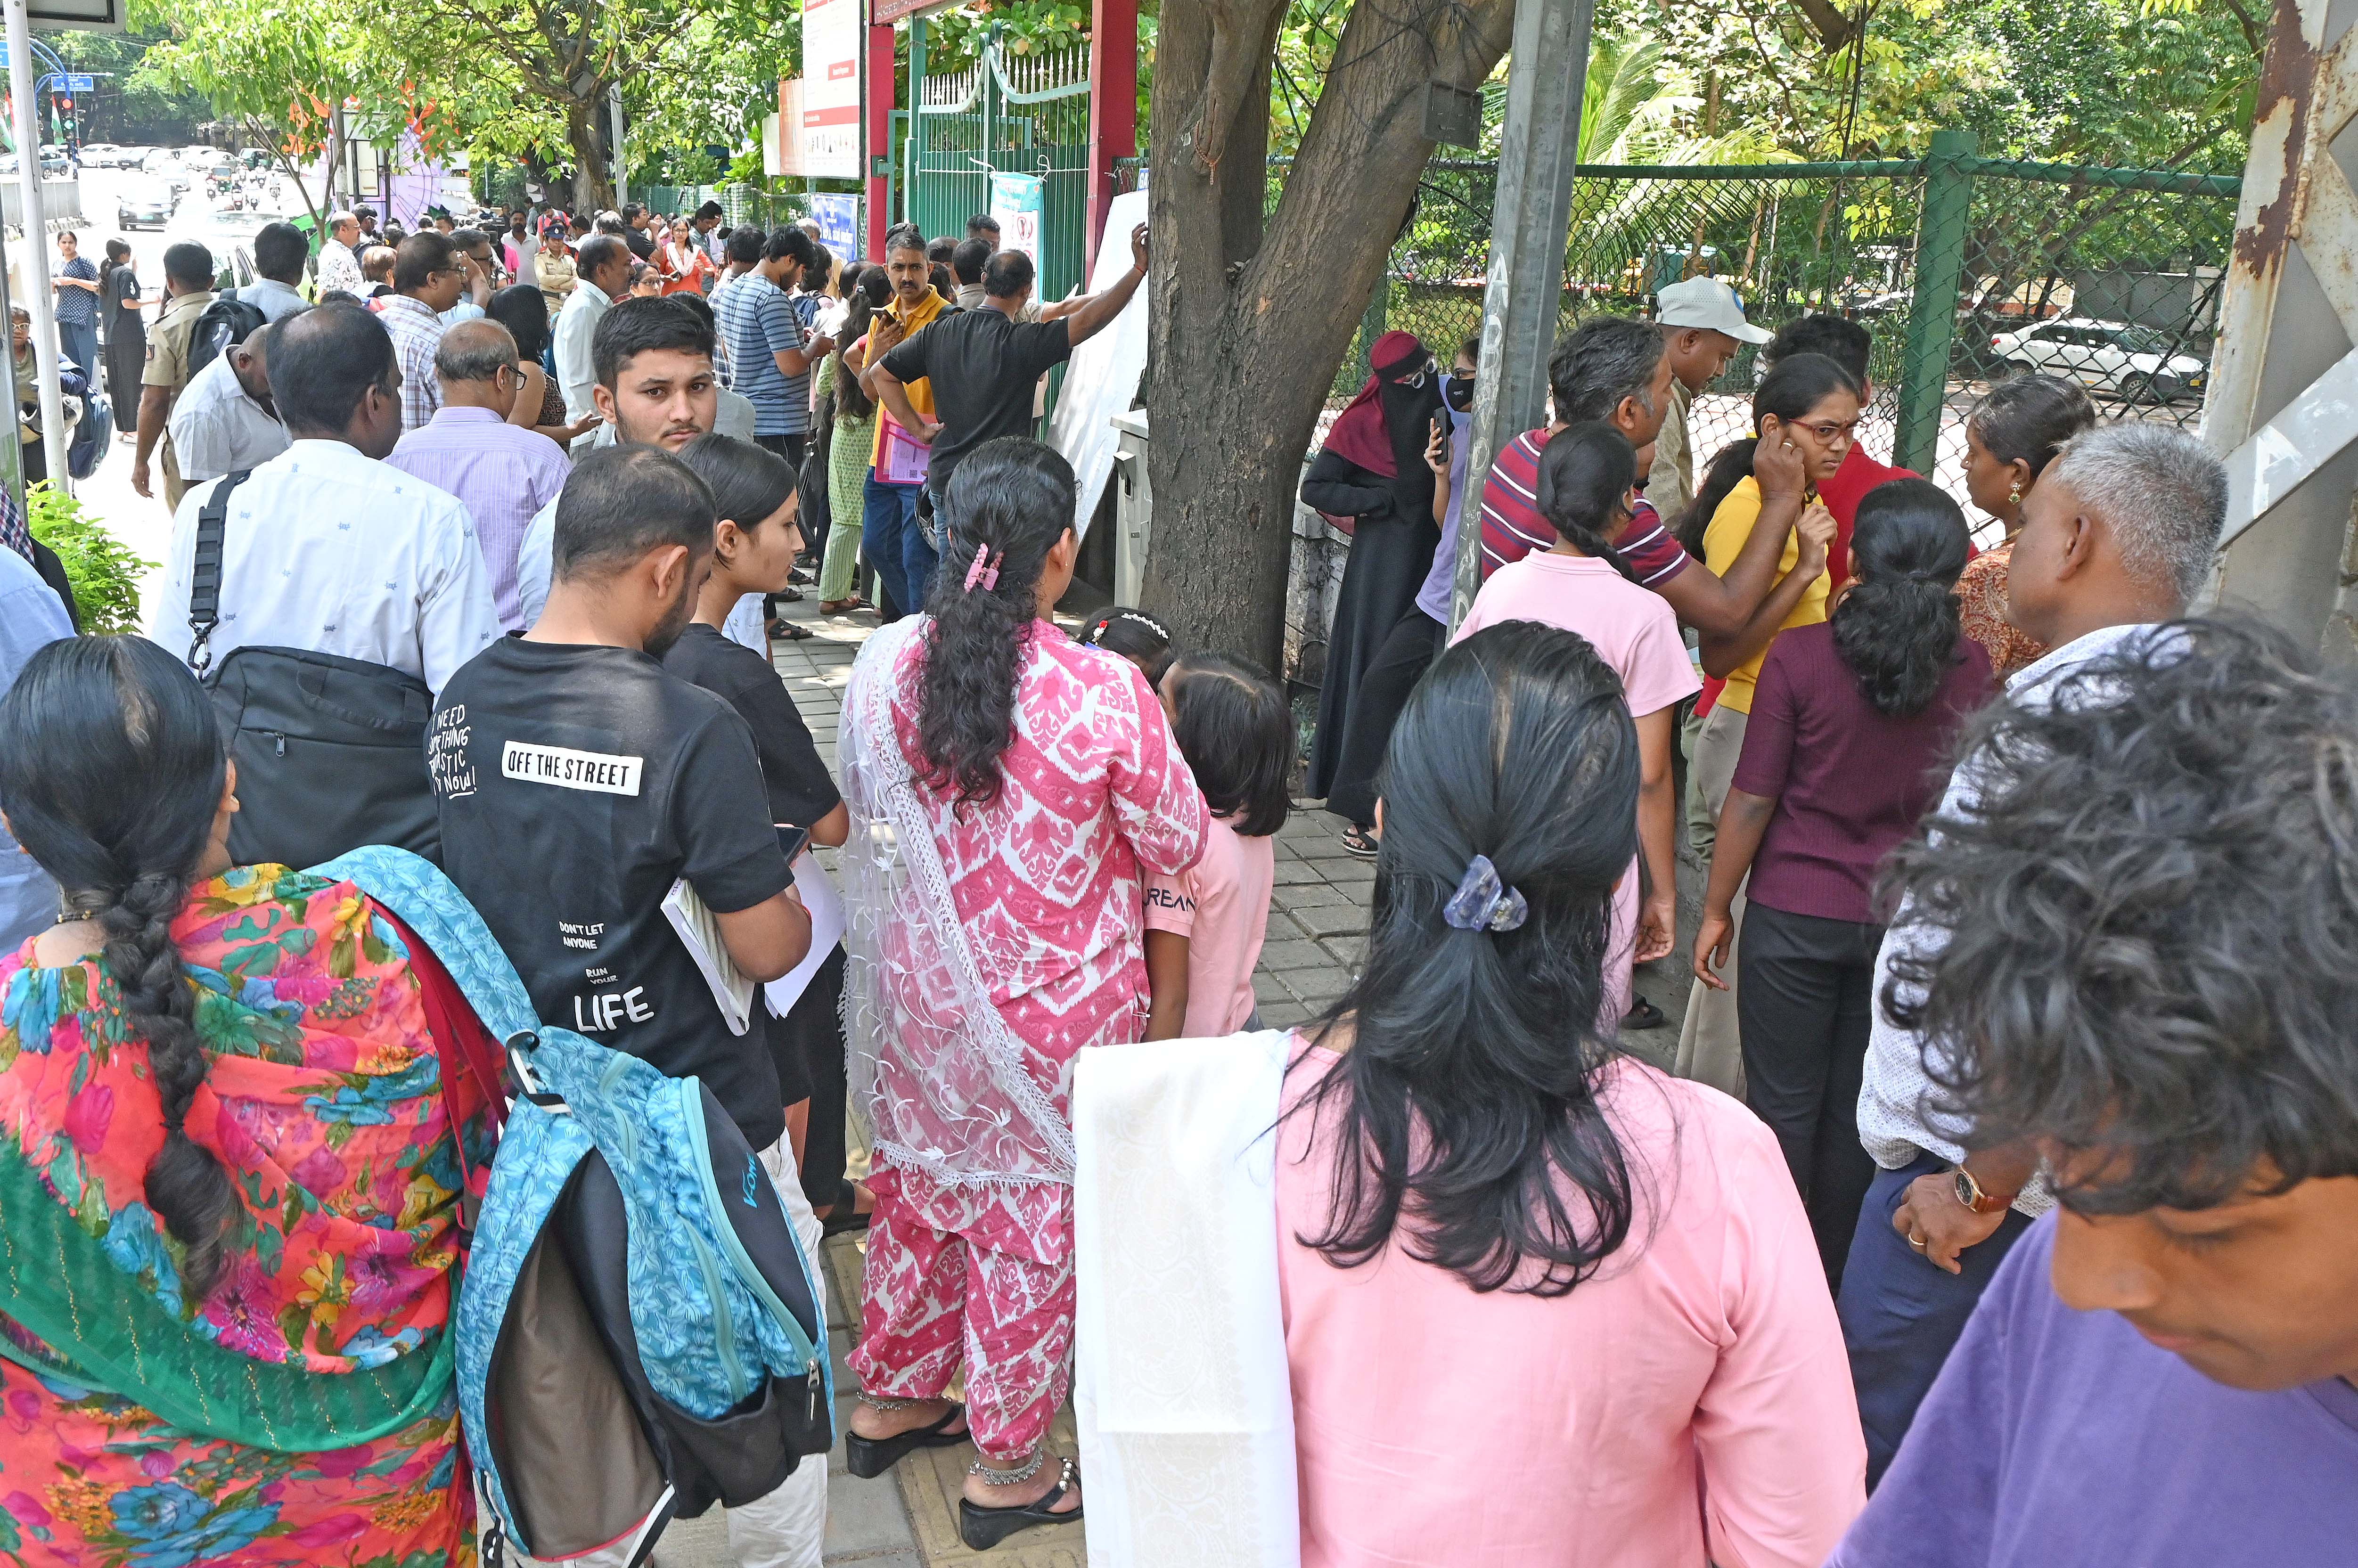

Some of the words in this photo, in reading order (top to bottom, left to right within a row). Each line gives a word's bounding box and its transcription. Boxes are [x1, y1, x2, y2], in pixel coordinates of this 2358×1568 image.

[1139, 172, 1149, 189] GA
[431, 712, 436, 735] I
[437, 704, 465, 731] NEED
[508, 751, 532, 773] OFF
[537, 754, 560, 778] THE
[565, 759, 630, 787] STREET
[444, 766, 477, 793] NOW!
[559, 921, 583, 935] DON'T
[585, 923, 604, 935] LET
[563, 936, 598, 950] ANYONE
[585, 967, 608, 978] RUN
[590, 975, 618, 985] YOUR
[574, 986, 655, 1032] LIFE
